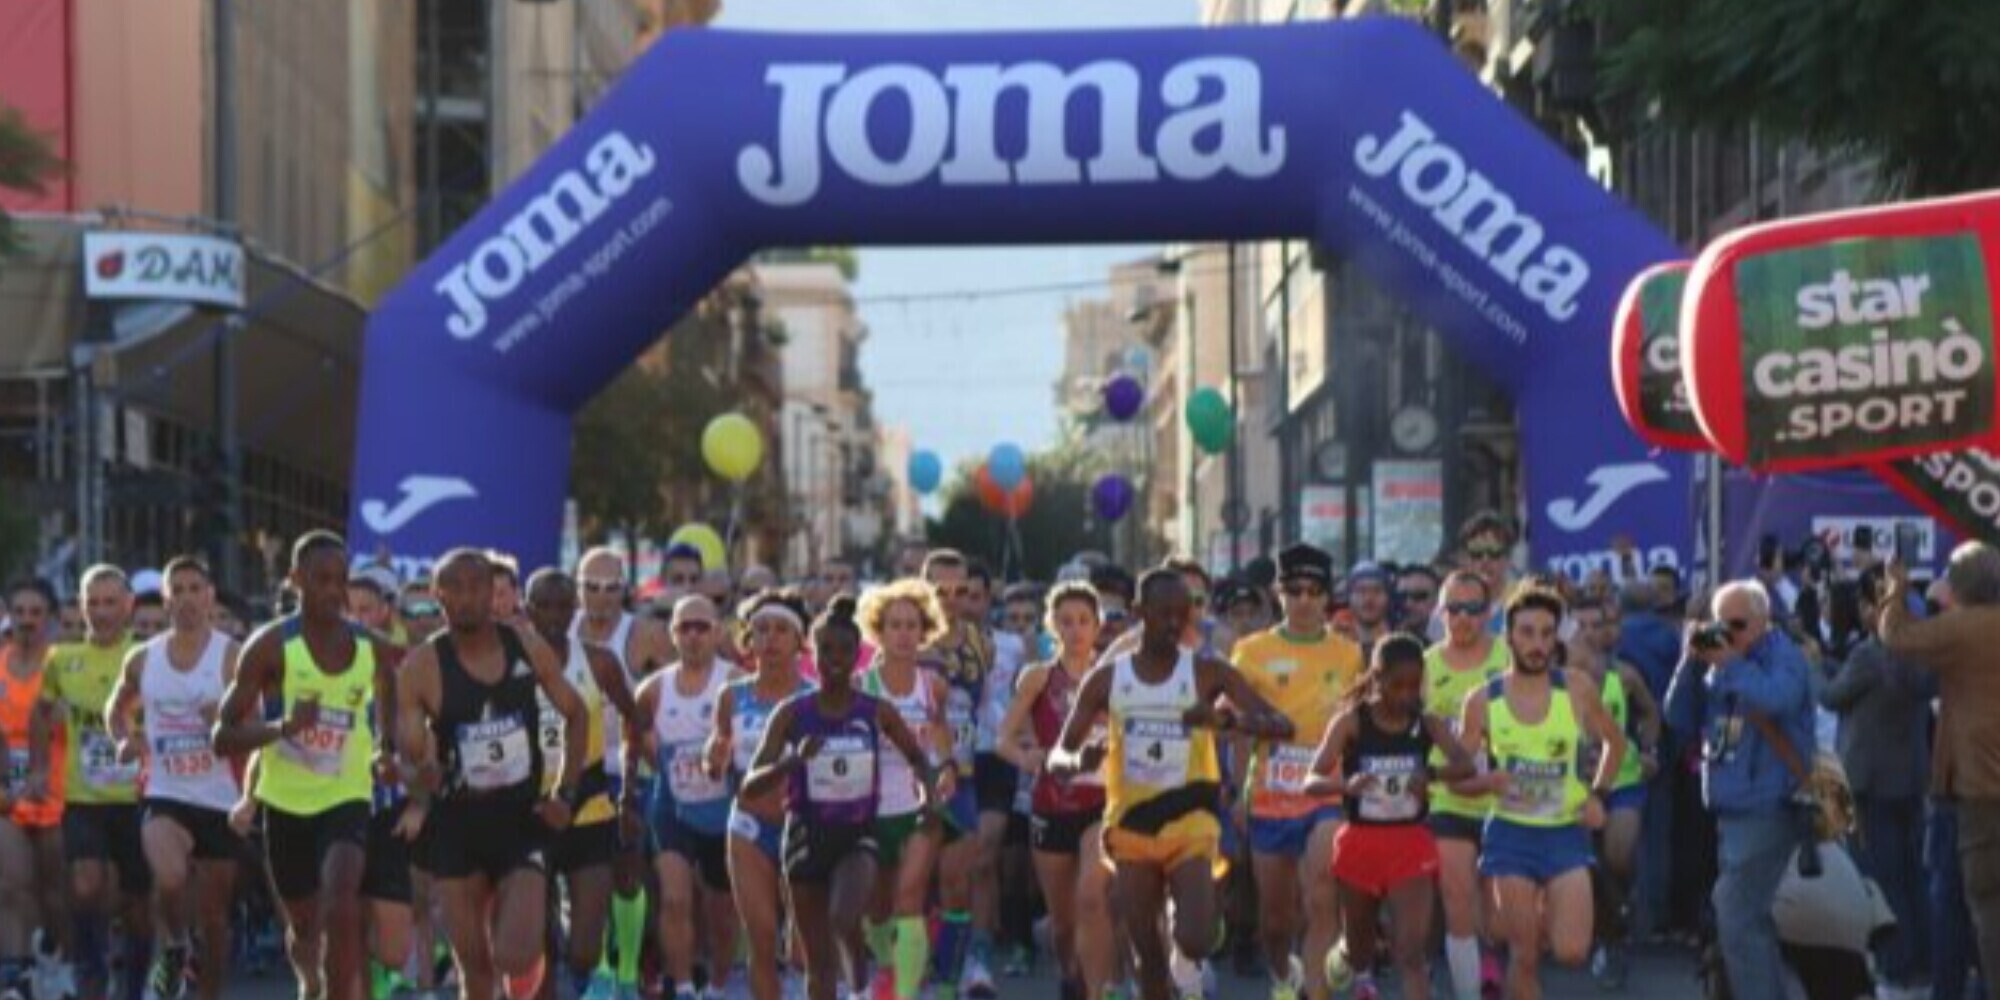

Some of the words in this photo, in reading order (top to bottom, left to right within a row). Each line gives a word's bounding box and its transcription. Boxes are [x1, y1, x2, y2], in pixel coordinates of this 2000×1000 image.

[737, 54, 1287, 207] Joma
[434, 130, 656, 340] Joma
[1353, 109, 1591, 322] Joma
[1796, 269, 1931, 328] star
[1753, 317, 1983, 398] casinò
[1775, 390, 1967, 441] .SPORT
[486, 740, 504, 763] 3
